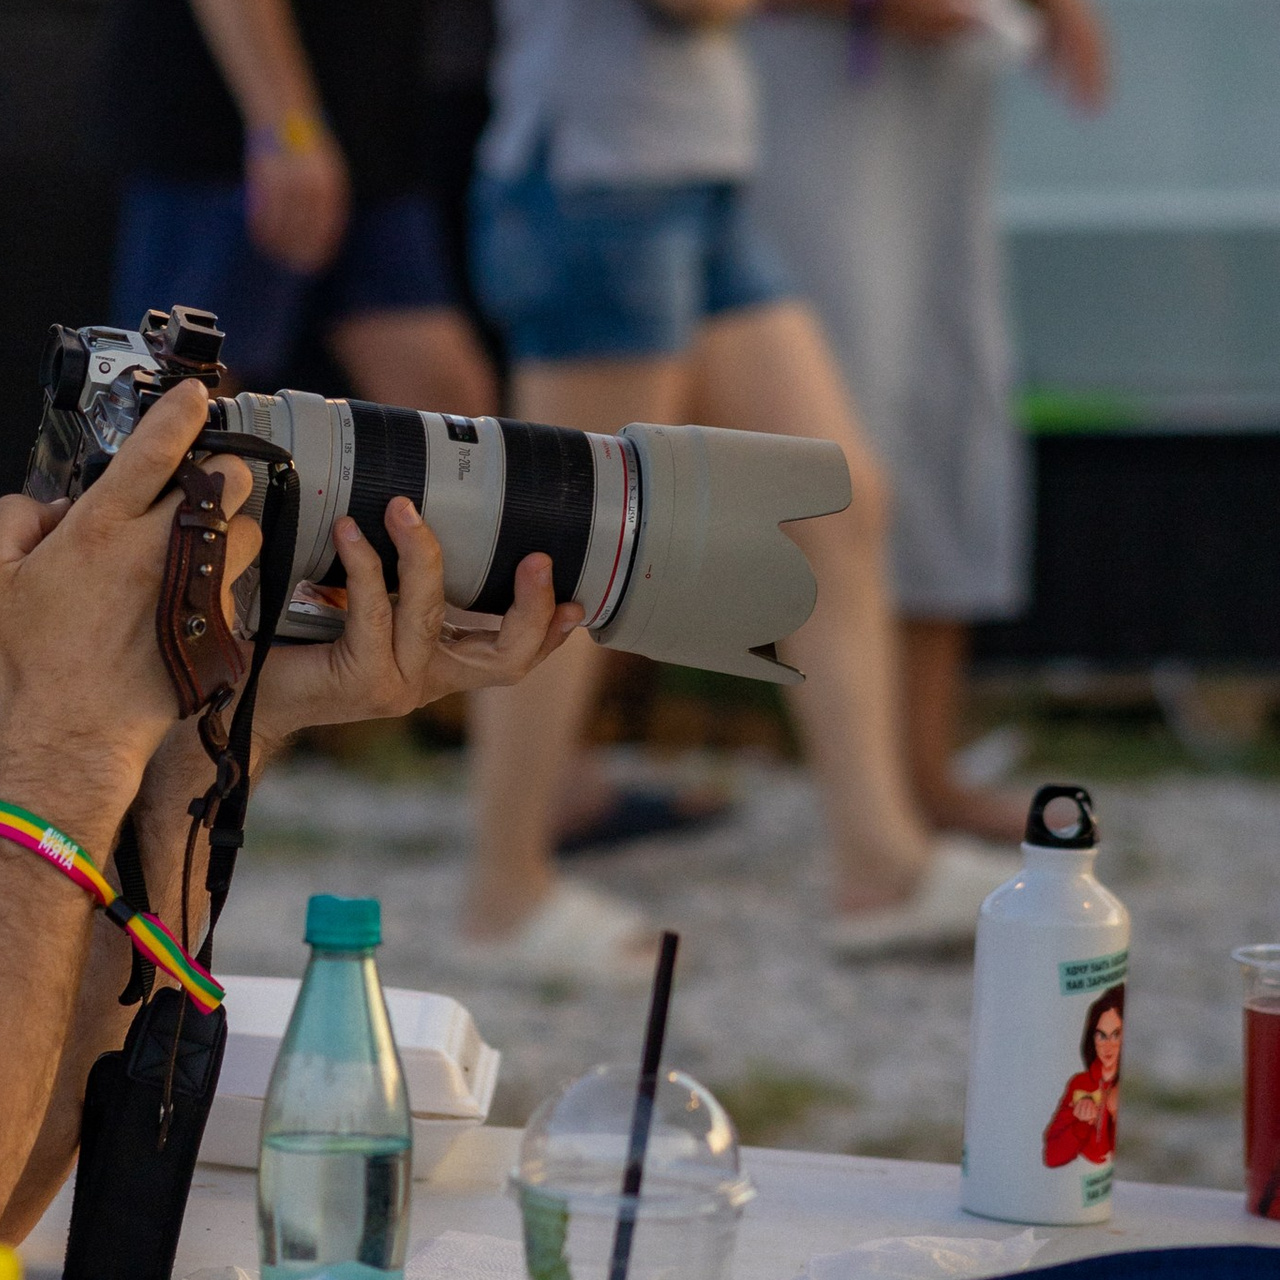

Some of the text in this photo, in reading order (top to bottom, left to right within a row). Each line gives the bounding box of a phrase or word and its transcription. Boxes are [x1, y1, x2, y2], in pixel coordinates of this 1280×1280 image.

[342, 417, 352, 481] 100 135 200
[38, 834, 75, 870] МЯТА
